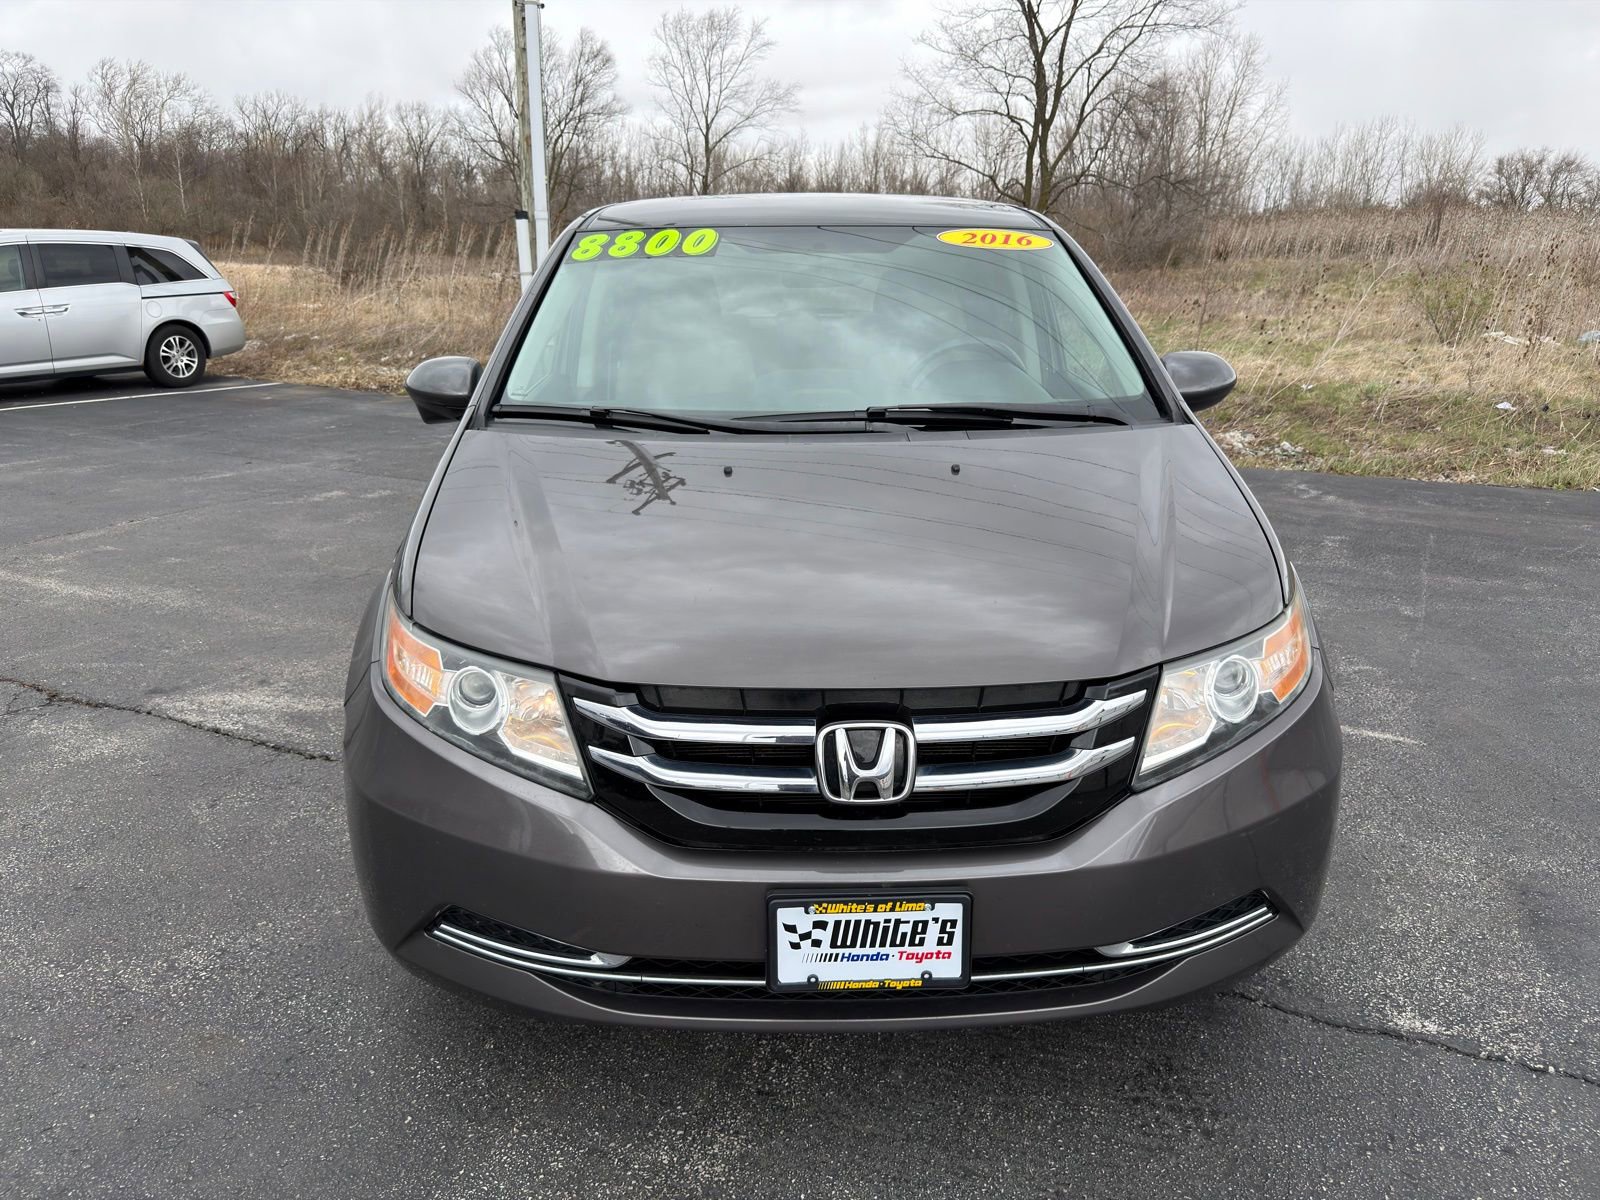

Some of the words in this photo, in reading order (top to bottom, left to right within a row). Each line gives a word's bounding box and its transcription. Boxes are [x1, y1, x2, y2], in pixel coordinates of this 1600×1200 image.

[571, 228, 719, 261] 8800
[962, 232, 1032, 246] 2016
[827, 902, 874, 913] White's
[877, 902, 893, 912] of
[895, 901, 925, 912] Lima
[829, 917, 958, 949] White's
[840, 951, 890, 962] Honda
[898, 950, 952, 963] Toyota
[844, 980, 880, 989] Honda
[884, 979, 922, 989] Toyota
